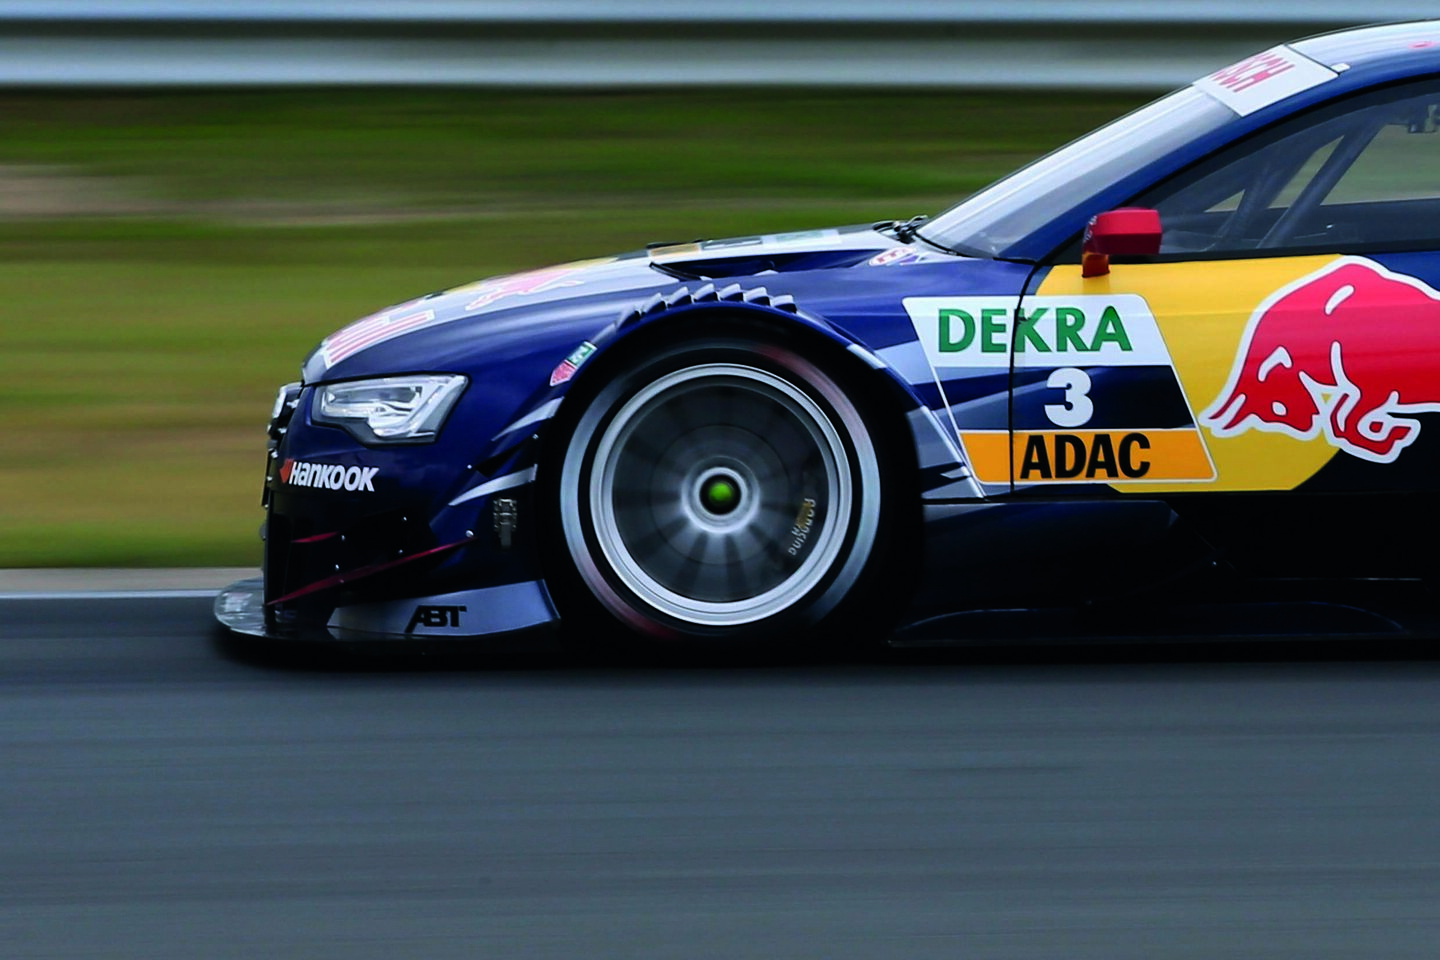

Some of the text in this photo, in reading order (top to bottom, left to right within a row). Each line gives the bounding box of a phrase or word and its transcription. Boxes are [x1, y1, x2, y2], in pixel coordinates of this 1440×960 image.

[938, 305, 1133, 353] DEKRA
[1044, 367, 1093, 427] 3
[1019, 432, 1151, 479] ADAC
[404, 605, 467, 635] ABT
